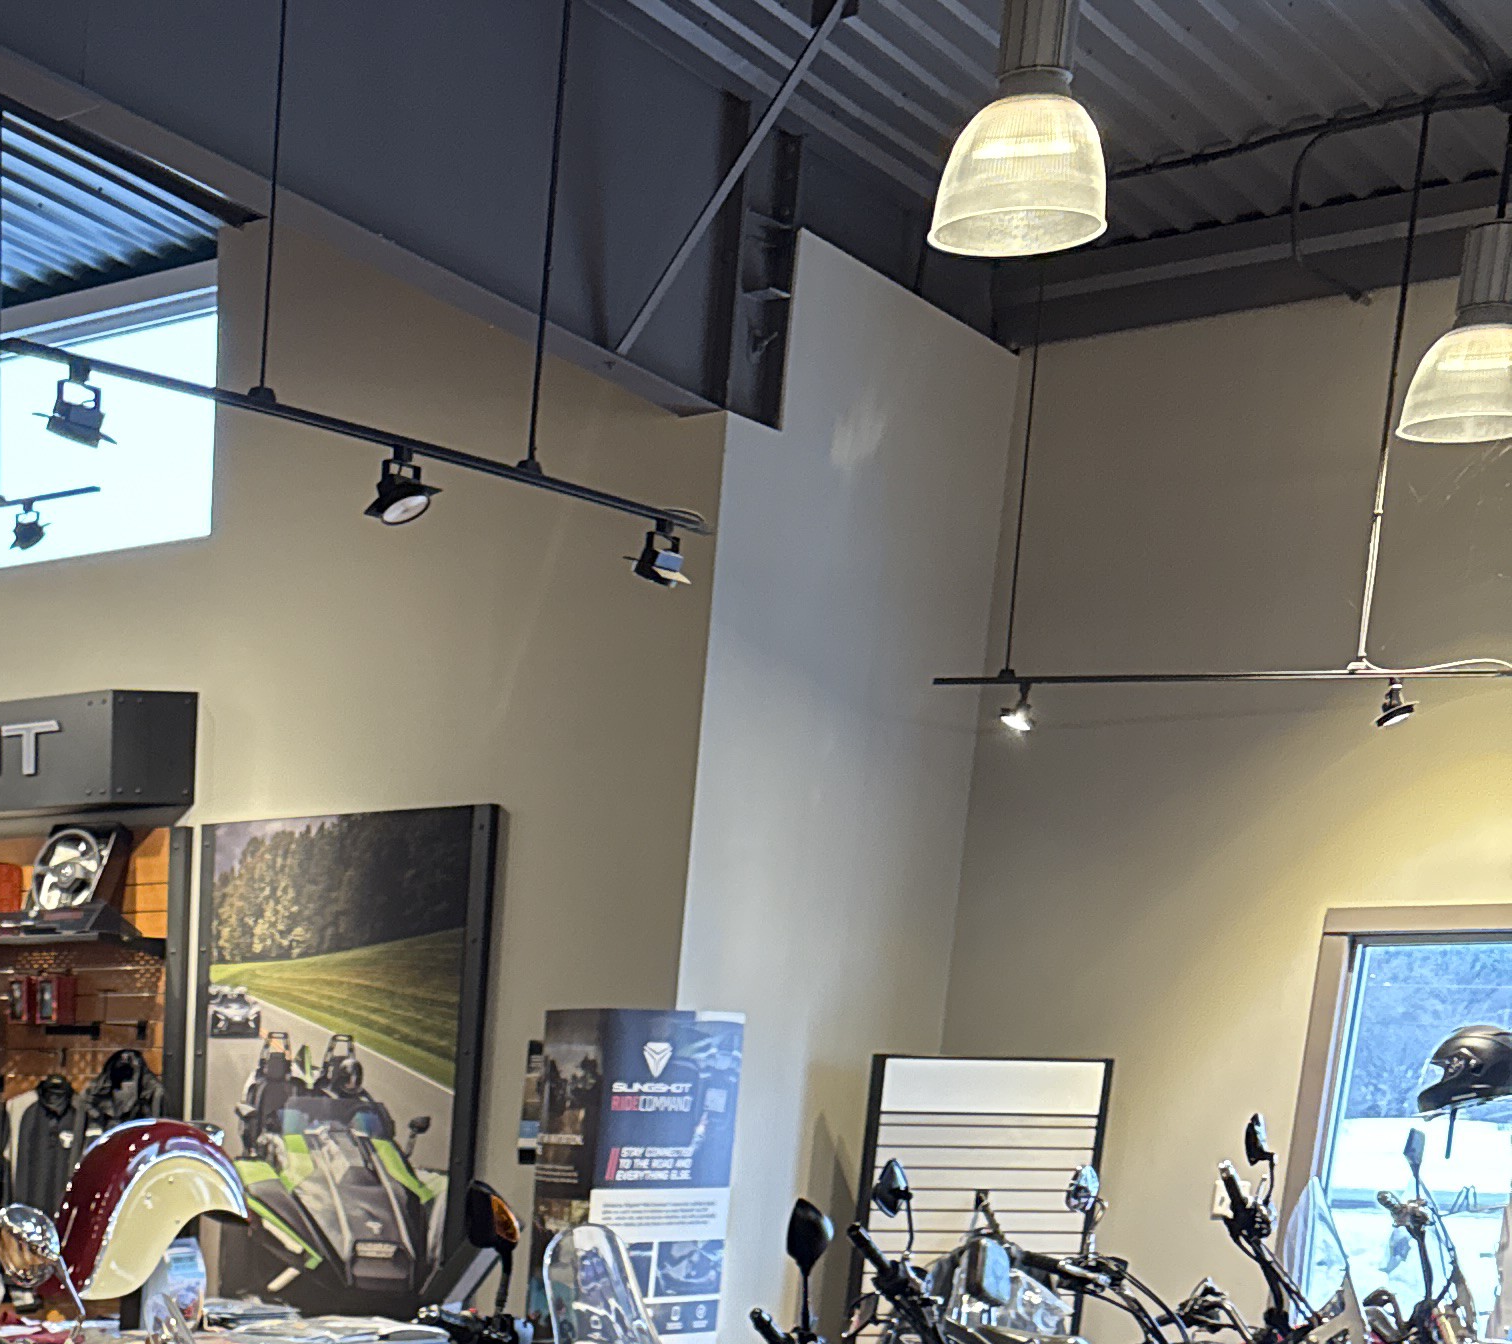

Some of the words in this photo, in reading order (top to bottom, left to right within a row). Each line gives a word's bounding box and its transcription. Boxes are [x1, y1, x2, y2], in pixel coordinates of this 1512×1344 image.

[611, 1082, 693, 1093] SLINGSHOT
[620, 1146, 645, 1158] STAY
[619, 1158, 632, 1169] TO
[633, 1158, 649, 1169] THE
[675, 1158, 692, 1169] AND
[615, 1170, 669, 1182] EVERYTHING
